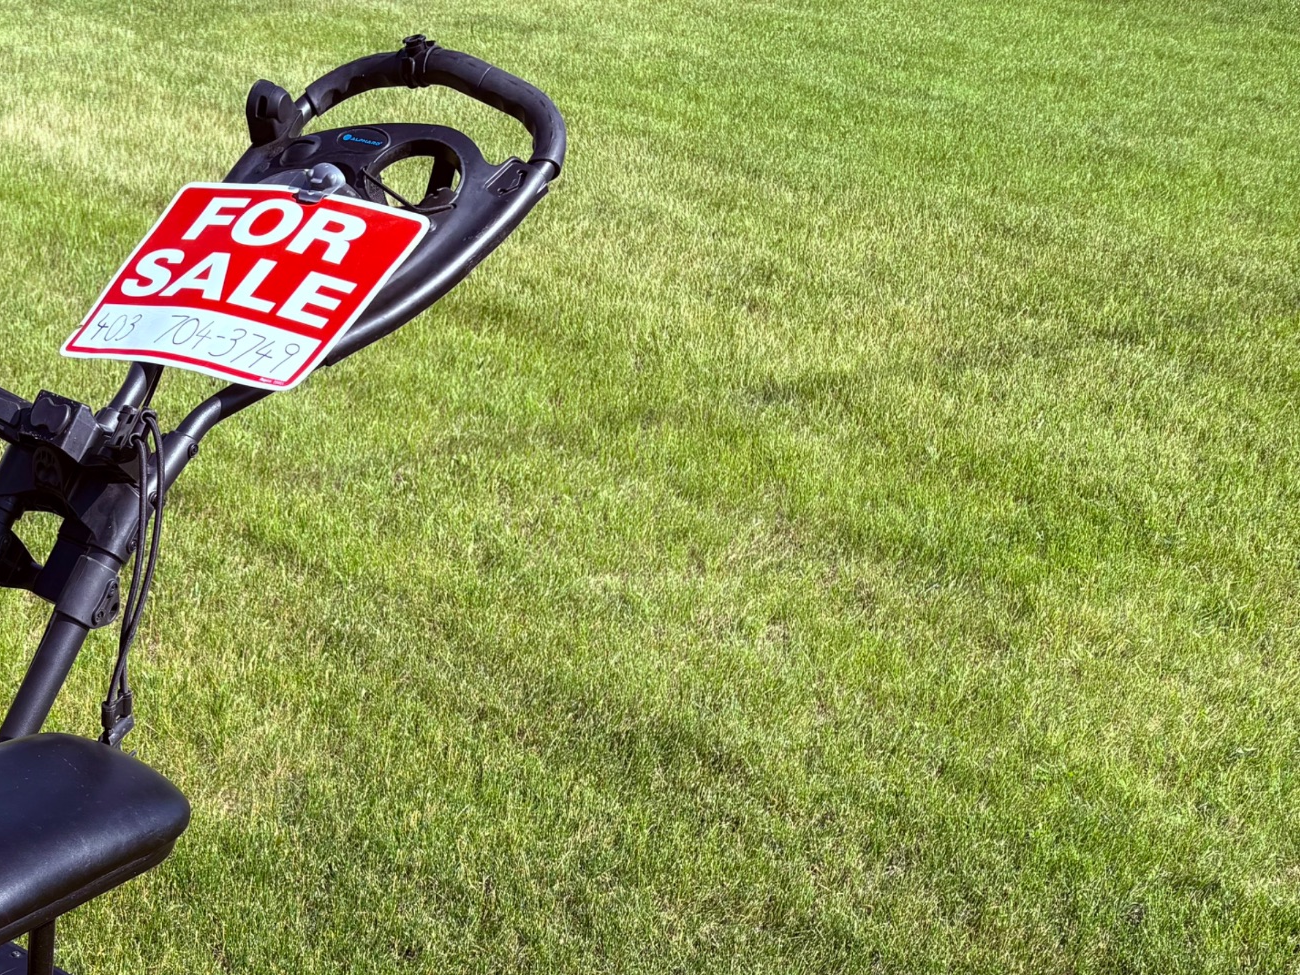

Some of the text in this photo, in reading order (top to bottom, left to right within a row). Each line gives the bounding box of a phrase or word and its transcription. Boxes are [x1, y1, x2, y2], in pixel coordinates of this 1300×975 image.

[350, 137, 381, 146] ALPHARD
[181, 196, 367, 265] FOR
[120, 248, 358, 329] SALE
[91, 313, 300, 373] 403 704-3749
